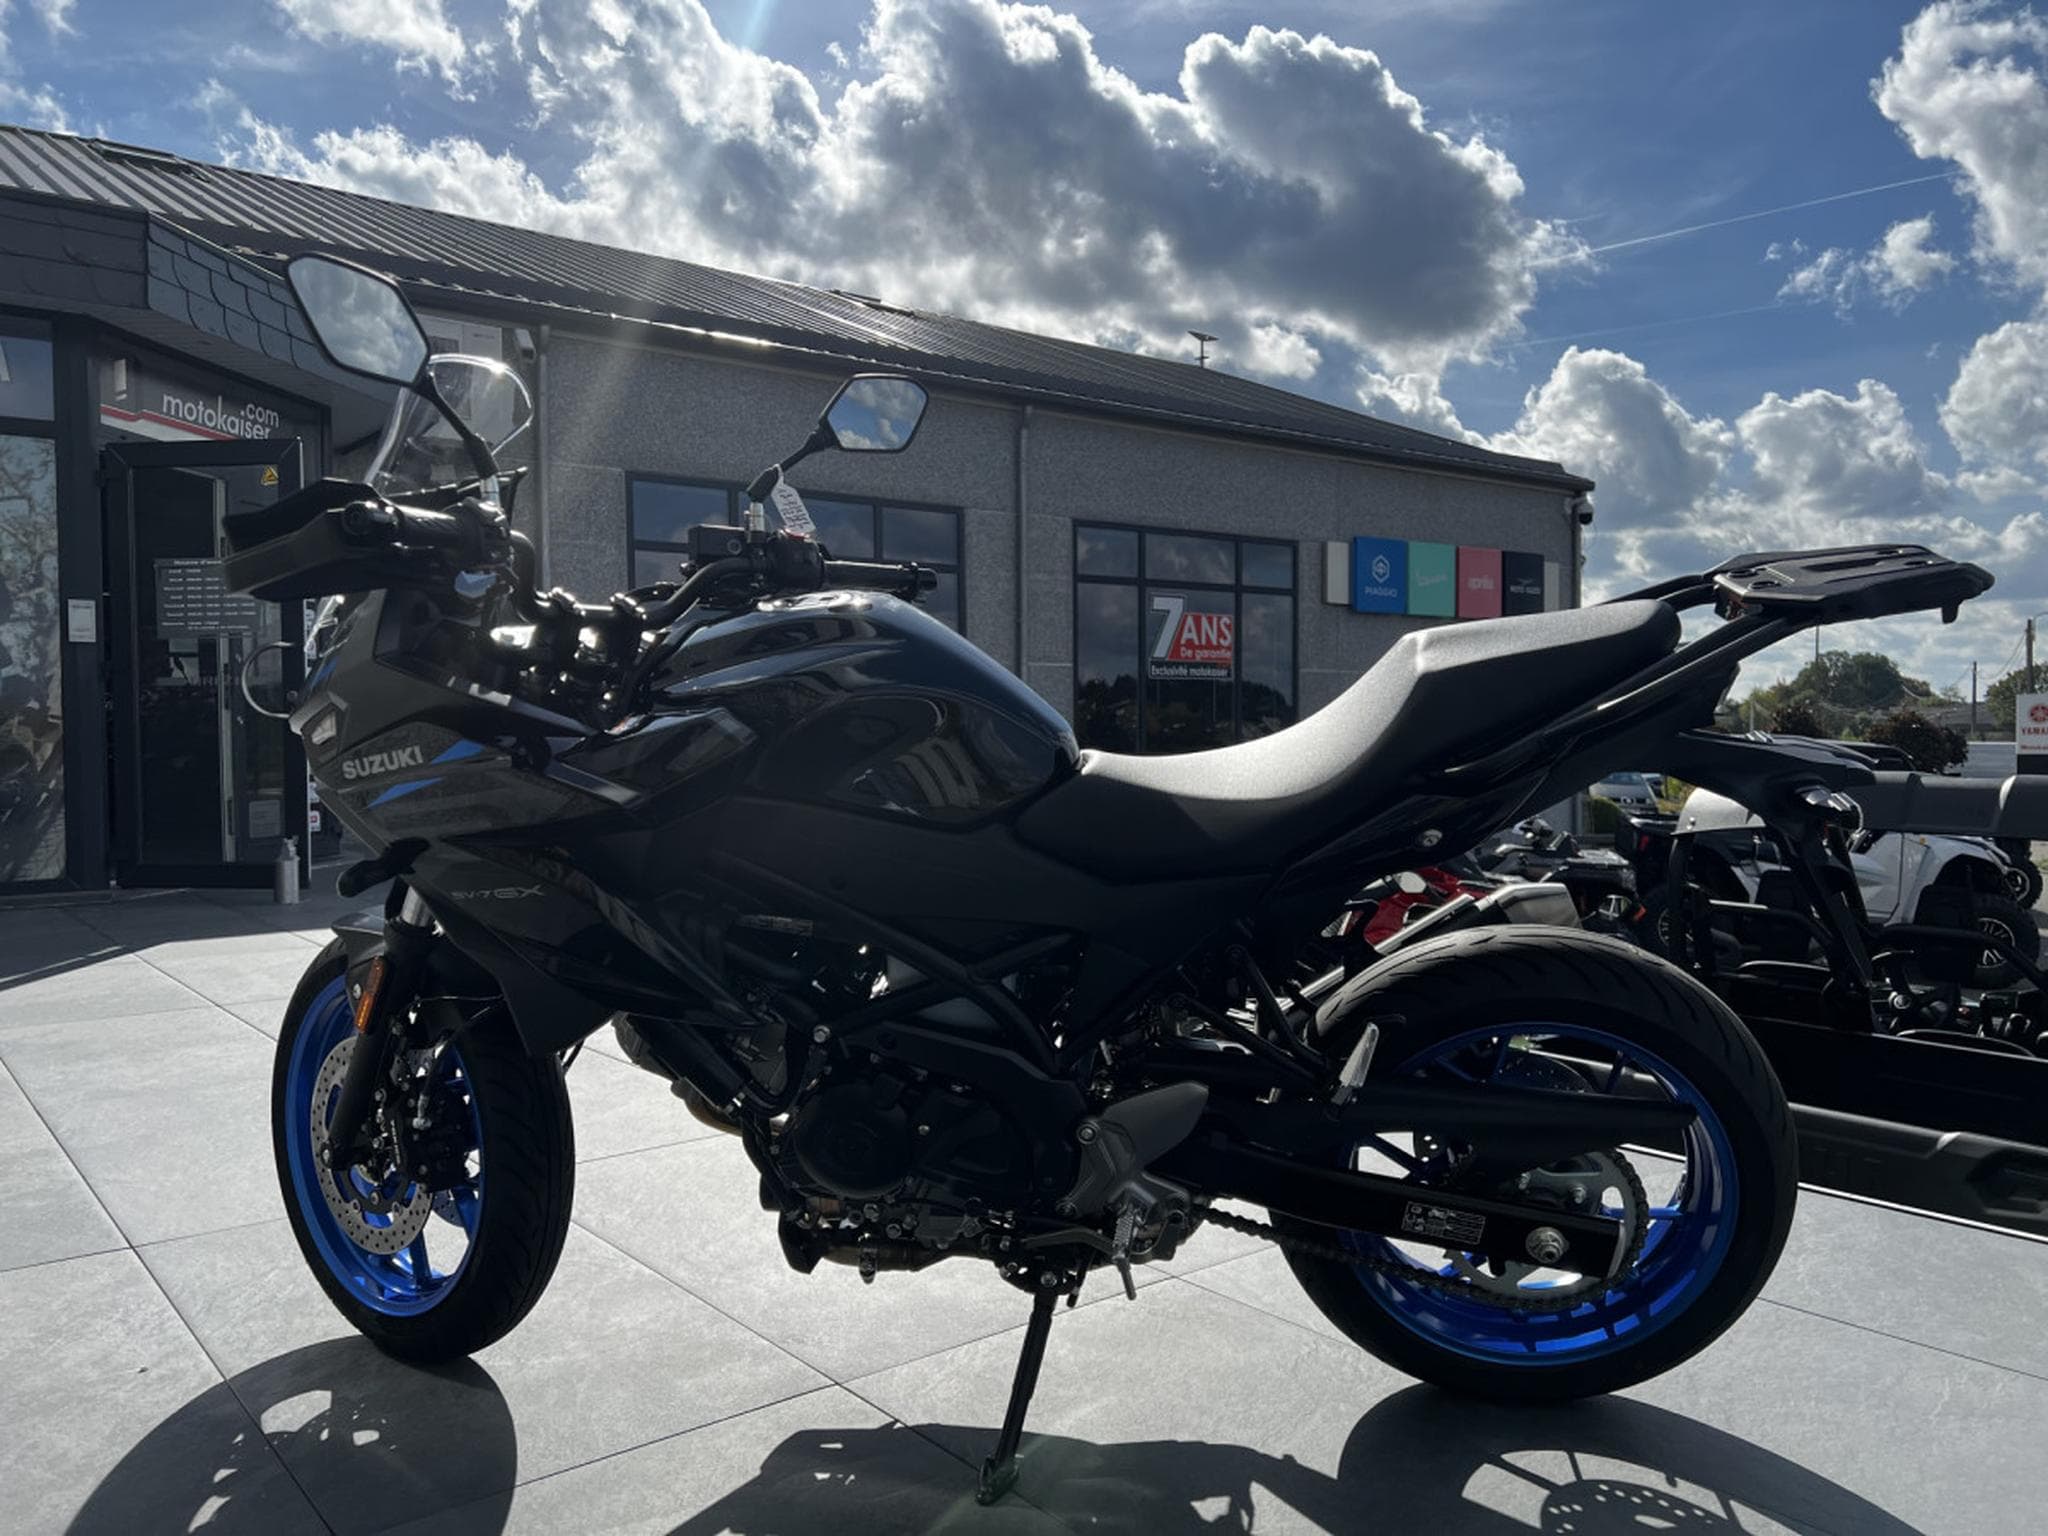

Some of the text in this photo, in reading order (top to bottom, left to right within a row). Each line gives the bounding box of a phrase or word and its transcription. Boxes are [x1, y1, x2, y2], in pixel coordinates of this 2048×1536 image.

[163, 393, 272, 440] motokaiser
[1152, 597, 1232, 658] 7 ANS
[1180, 647, 1193, 658] De
[342, 745, 423, 780] SUZUKI
